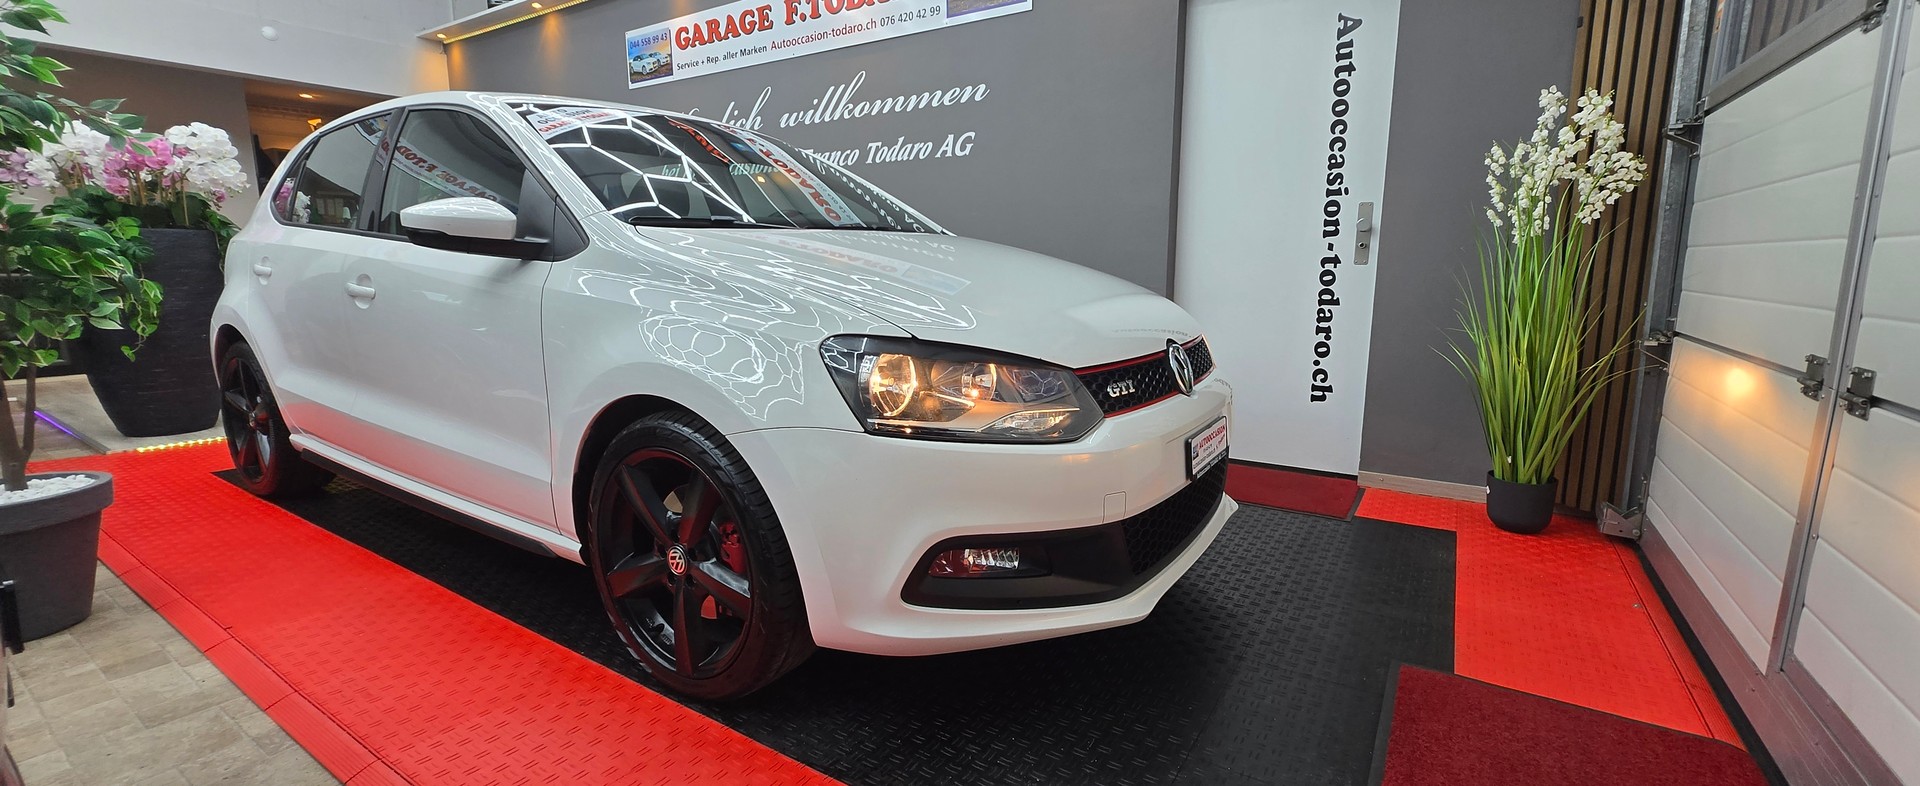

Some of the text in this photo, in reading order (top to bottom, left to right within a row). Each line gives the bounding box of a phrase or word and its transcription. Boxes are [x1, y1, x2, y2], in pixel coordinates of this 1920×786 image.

[629, 32, 668, 50] 044 558 99 43
[675, 4, 774, 51] GARAGE
[676, 60, 700, 71] Service
[706, 55, 721, 66] Rep.
[722, 51, 738, 61] aller
[739, 44, 768, 58] Marken
[770, 18, 877, 51] Autooccasion-todaro.ch
[880, 16, 895, 27] 076
[898, 13, 914, 24] 420
[916, 9, 928, 20] 42
[929, 5, 941, 16] 99
[778, 70, 991, 129] willkommen
[865, 135, 933, 165] Todaro
[935, 131, 976, 159] AG
[1309, 12, 1363, 404] Autooccasion-todaro.ch
[1106, 379, 1136, 398] GTI
